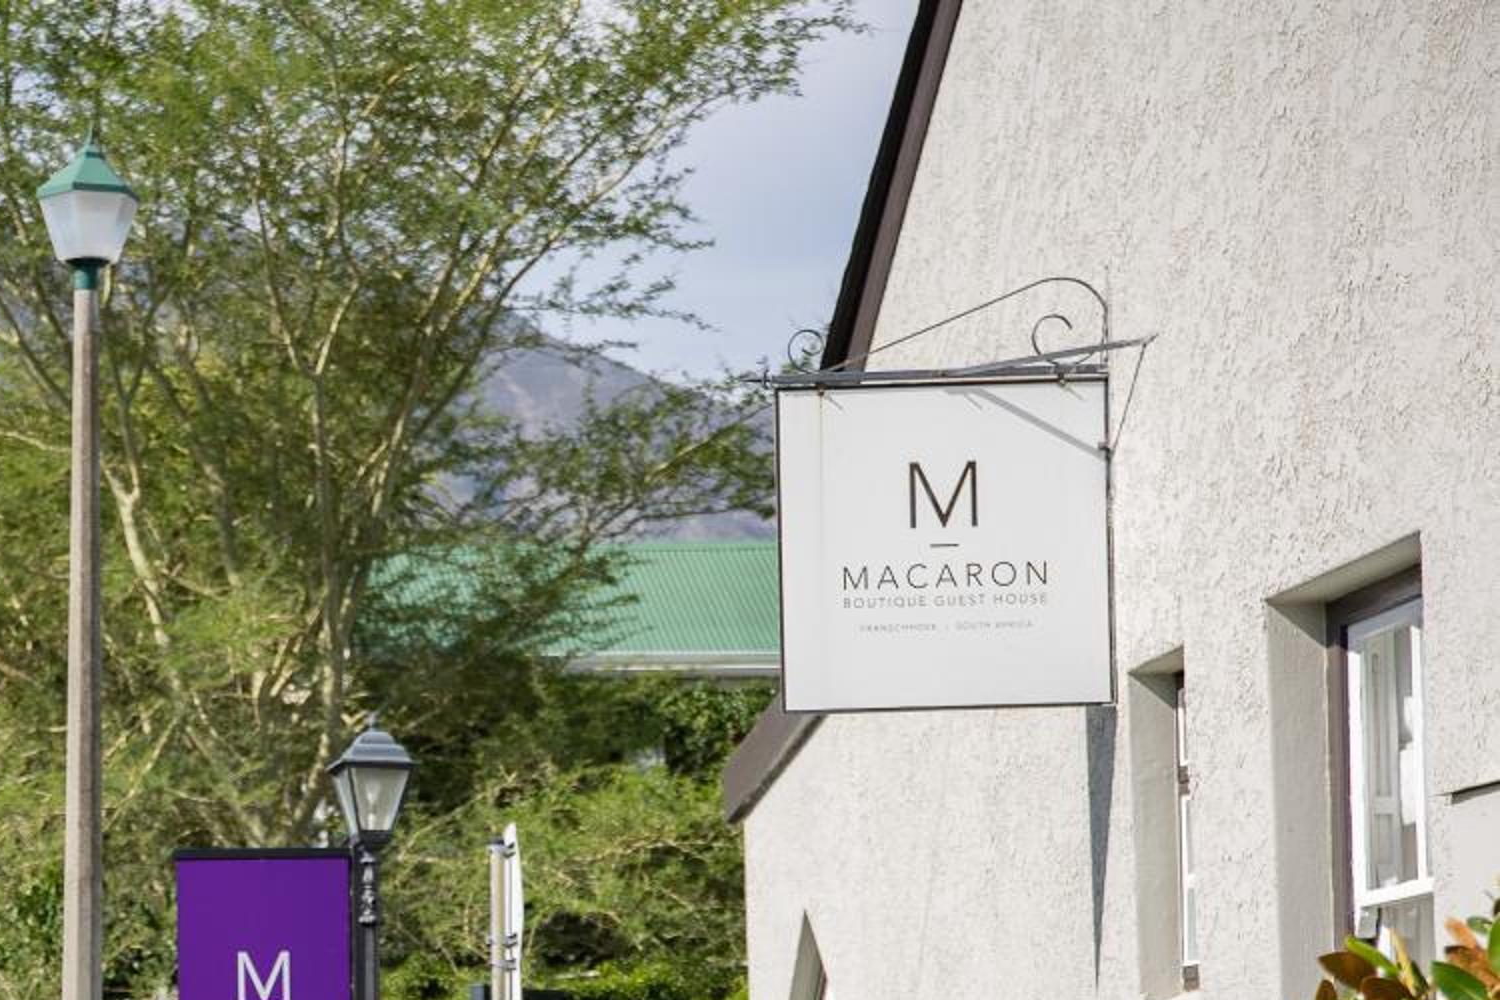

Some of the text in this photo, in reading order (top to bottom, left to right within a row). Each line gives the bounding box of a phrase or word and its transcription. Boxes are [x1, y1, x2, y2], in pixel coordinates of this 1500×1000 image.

[908, 460, 979, 529] M
[842, 560, 1048, 591] MACARON
[843, 591, 1048, 609] BOUTIQUE GUEST HOUSE
